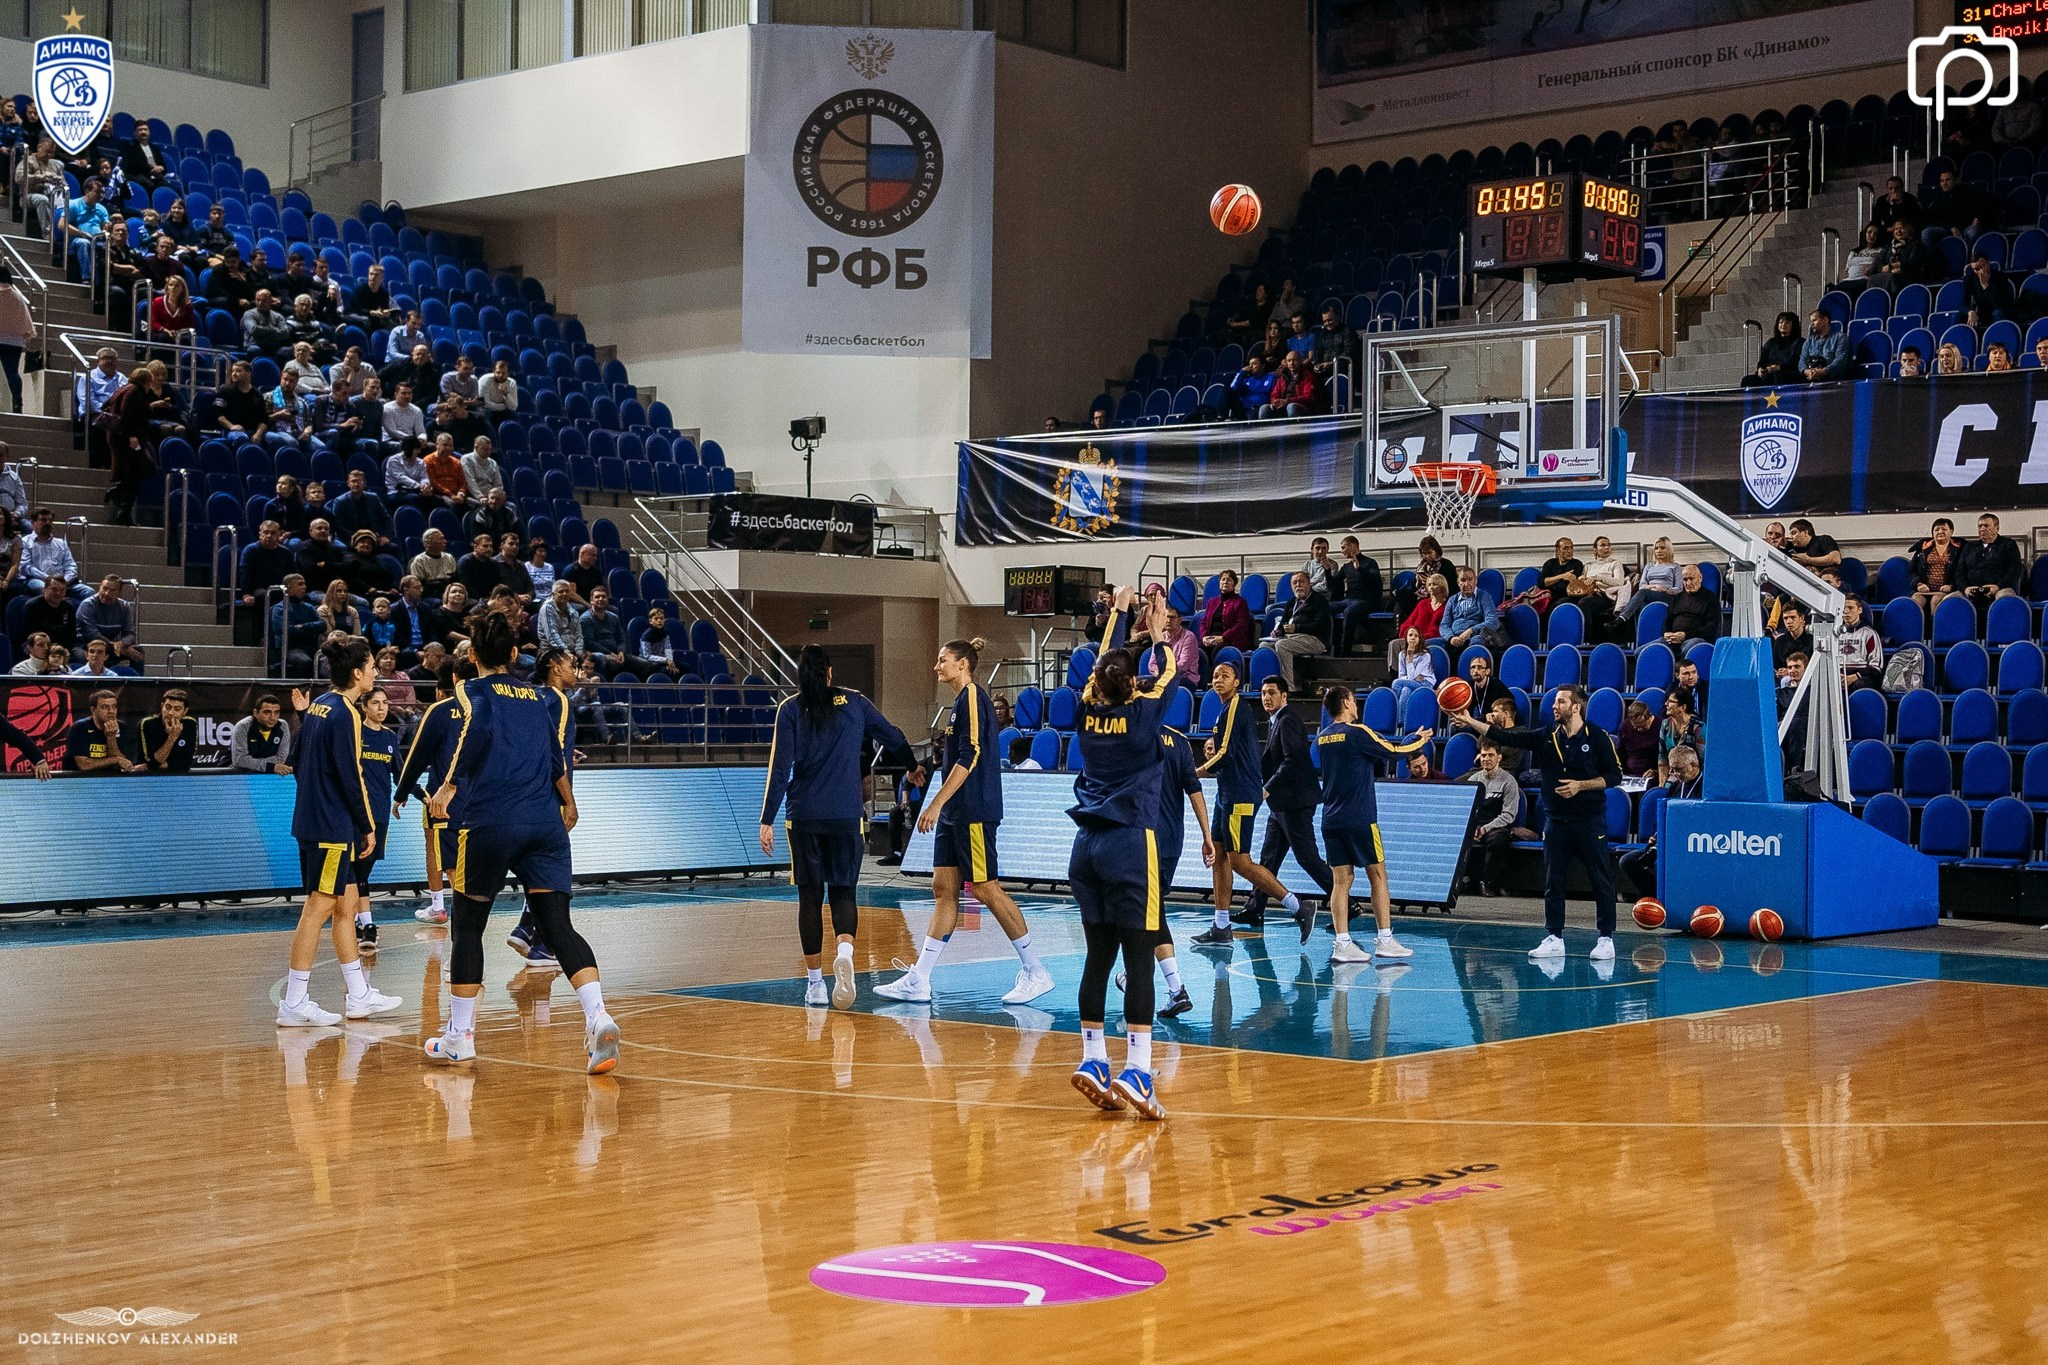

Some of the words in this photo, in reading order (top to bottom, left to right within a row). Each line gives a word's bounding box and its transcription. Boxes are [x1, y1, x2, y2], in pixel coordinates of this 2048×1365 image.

[1963, 7, 1981, 22] 31
[1538, 61, 1642, 88] Генеральный
[1645, 51, 1712, 73] спонсор
[1716, 46, 1738, 63] БК
[823, 97, 918, 126] ФЕДЕРАЦИЯ
[850, 218, 887, 229] 1991
[807, 246, 928, 290] РФБ
[804, 333, 925, 347] #здесьбаскетбол
[1746, 418, 1797, 435] ДИНАМО
[730, 511, 853, 534] #здесьбаскетбол
[492, 683, 514, 698] URAL
[512, 686, 538, 701] TOPUZ
[450, 708, 462, 719] ZA
[198, 717, 235, 746] lte
[1085, 715, 1127, 734] PLUM
[362, 751, 392, 763] NERBAHÇE
[1688, 830, 1780, 856] molten
[1093, 1163, 1500, 1245] EuroLeague
[1249, 1182, 1502, 1236] Women
